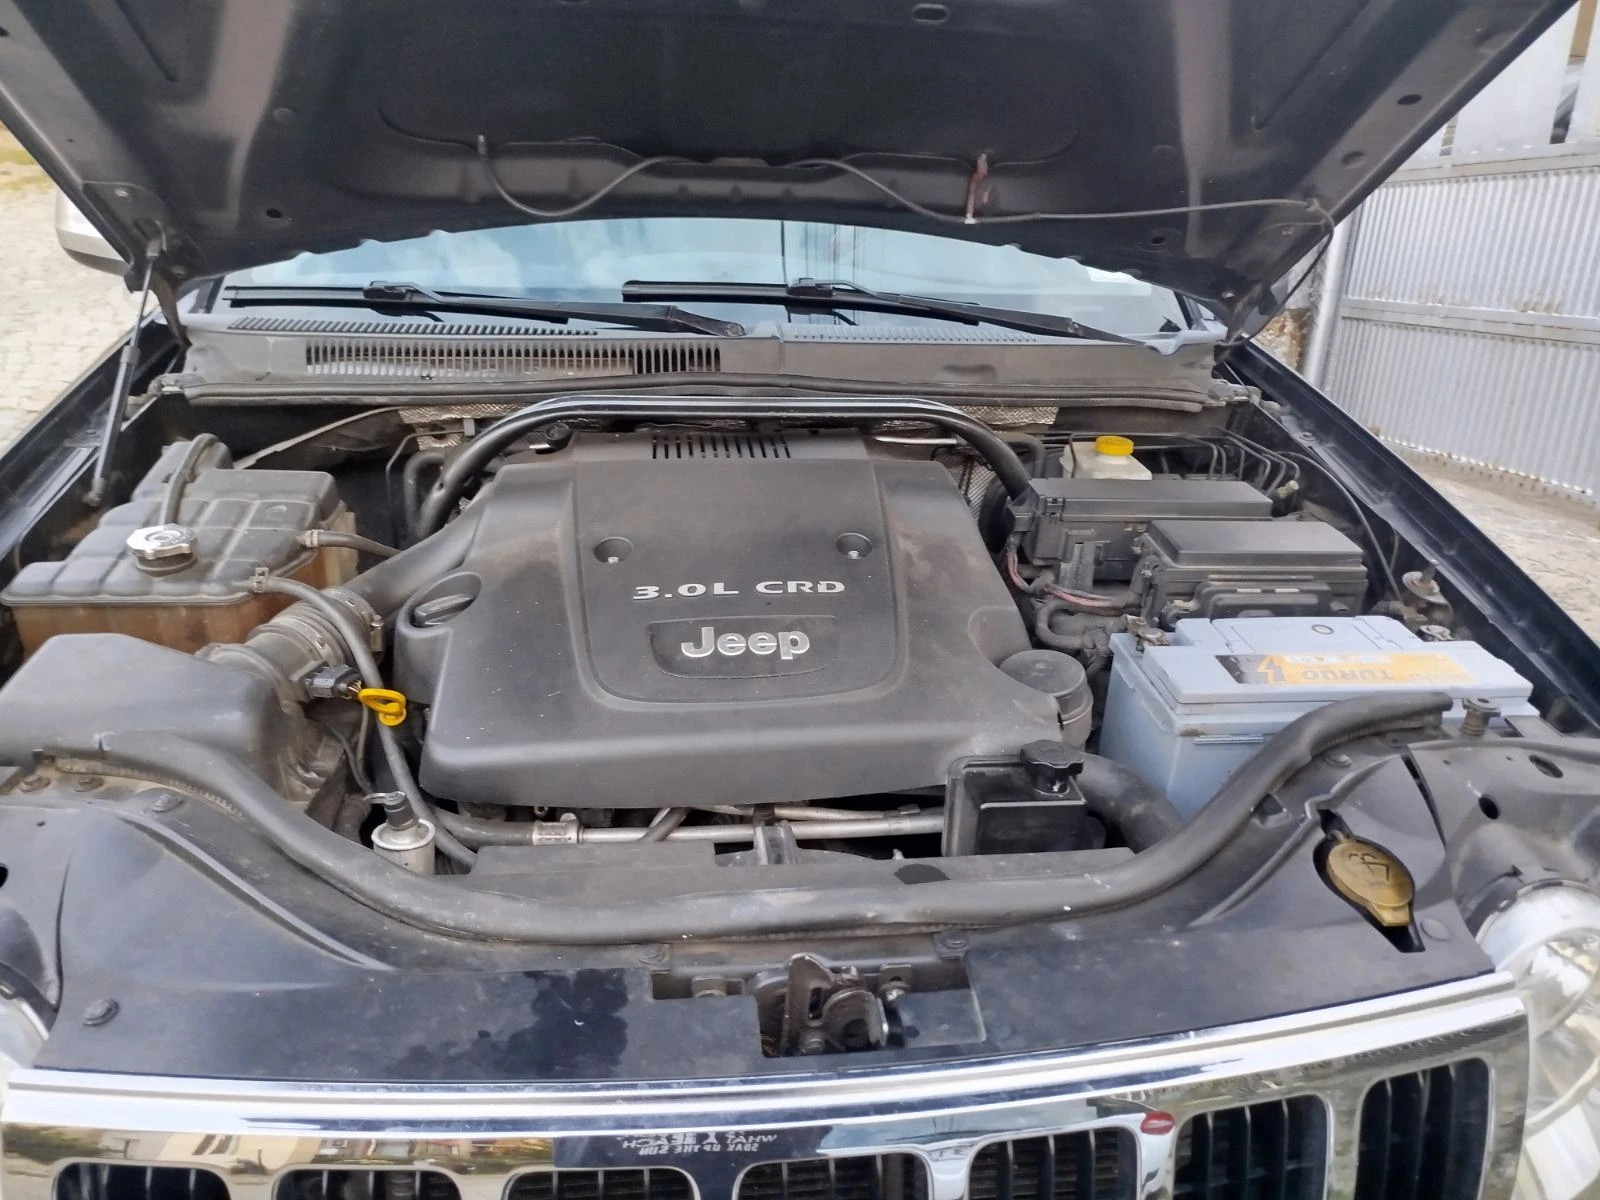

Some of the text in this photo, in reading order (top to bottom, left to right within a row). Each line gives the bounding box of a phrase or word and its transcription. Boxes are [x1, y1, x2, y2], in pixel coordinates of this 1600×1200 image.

[633, 580, 846, 600] 3.0L CRD
[681, 626, 811, 660] Jeep
